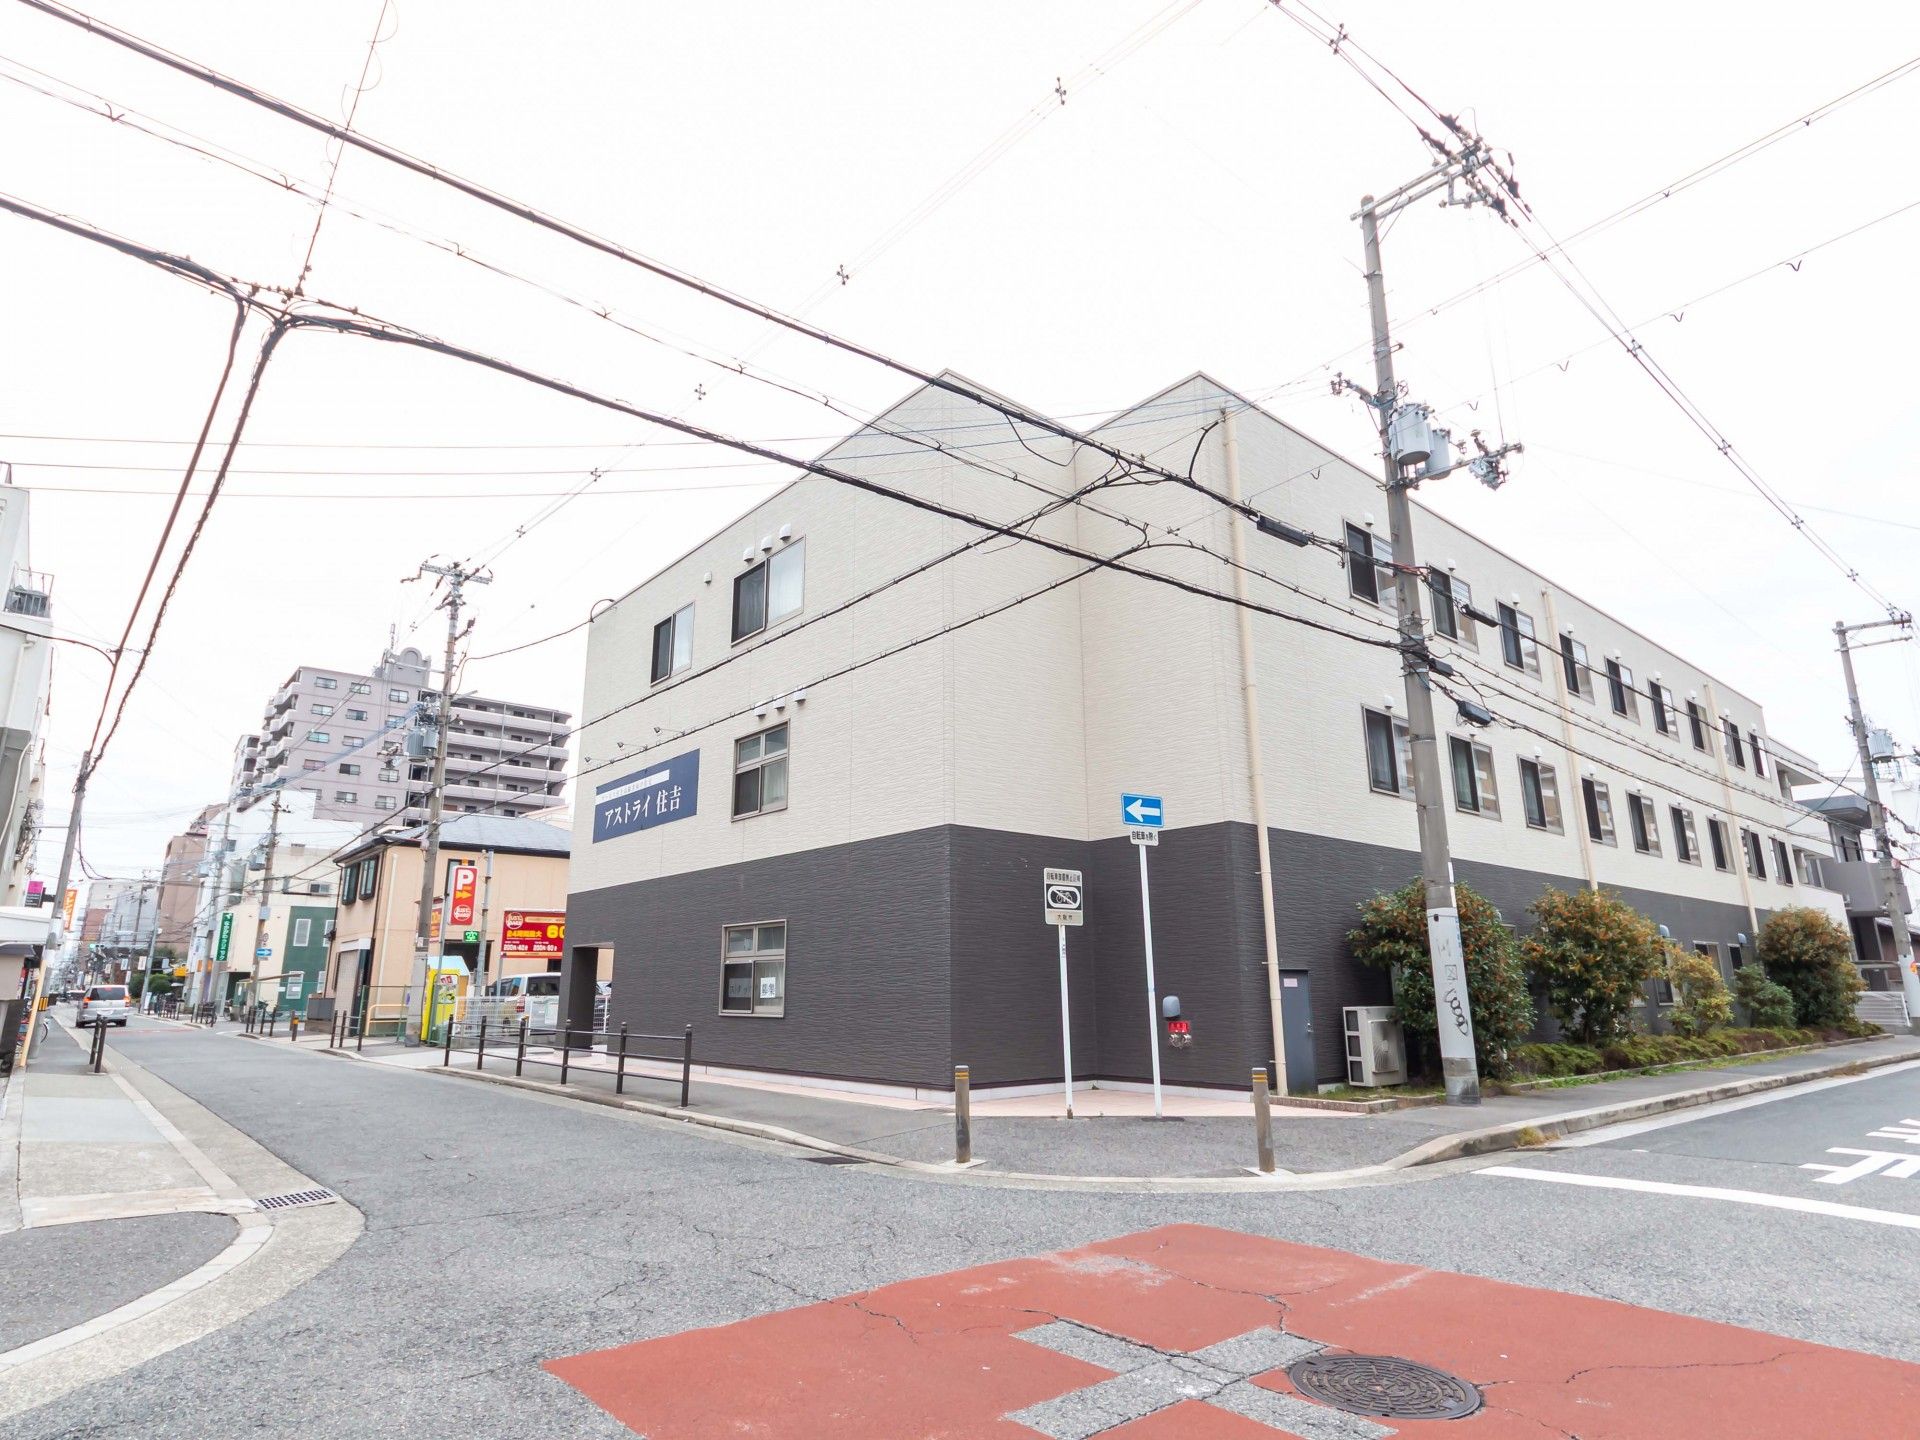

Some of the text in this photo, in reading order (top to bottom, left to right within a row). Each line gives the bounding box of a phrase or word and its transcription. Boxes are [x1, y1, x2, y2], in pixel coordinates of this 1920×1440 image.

[605, 795, 651, 830] アストライ
[656, 784, 682, 815] 住吉
[1131, 830, 1158, 842] 自転車を除く
[456, 869, 474, 890] P
